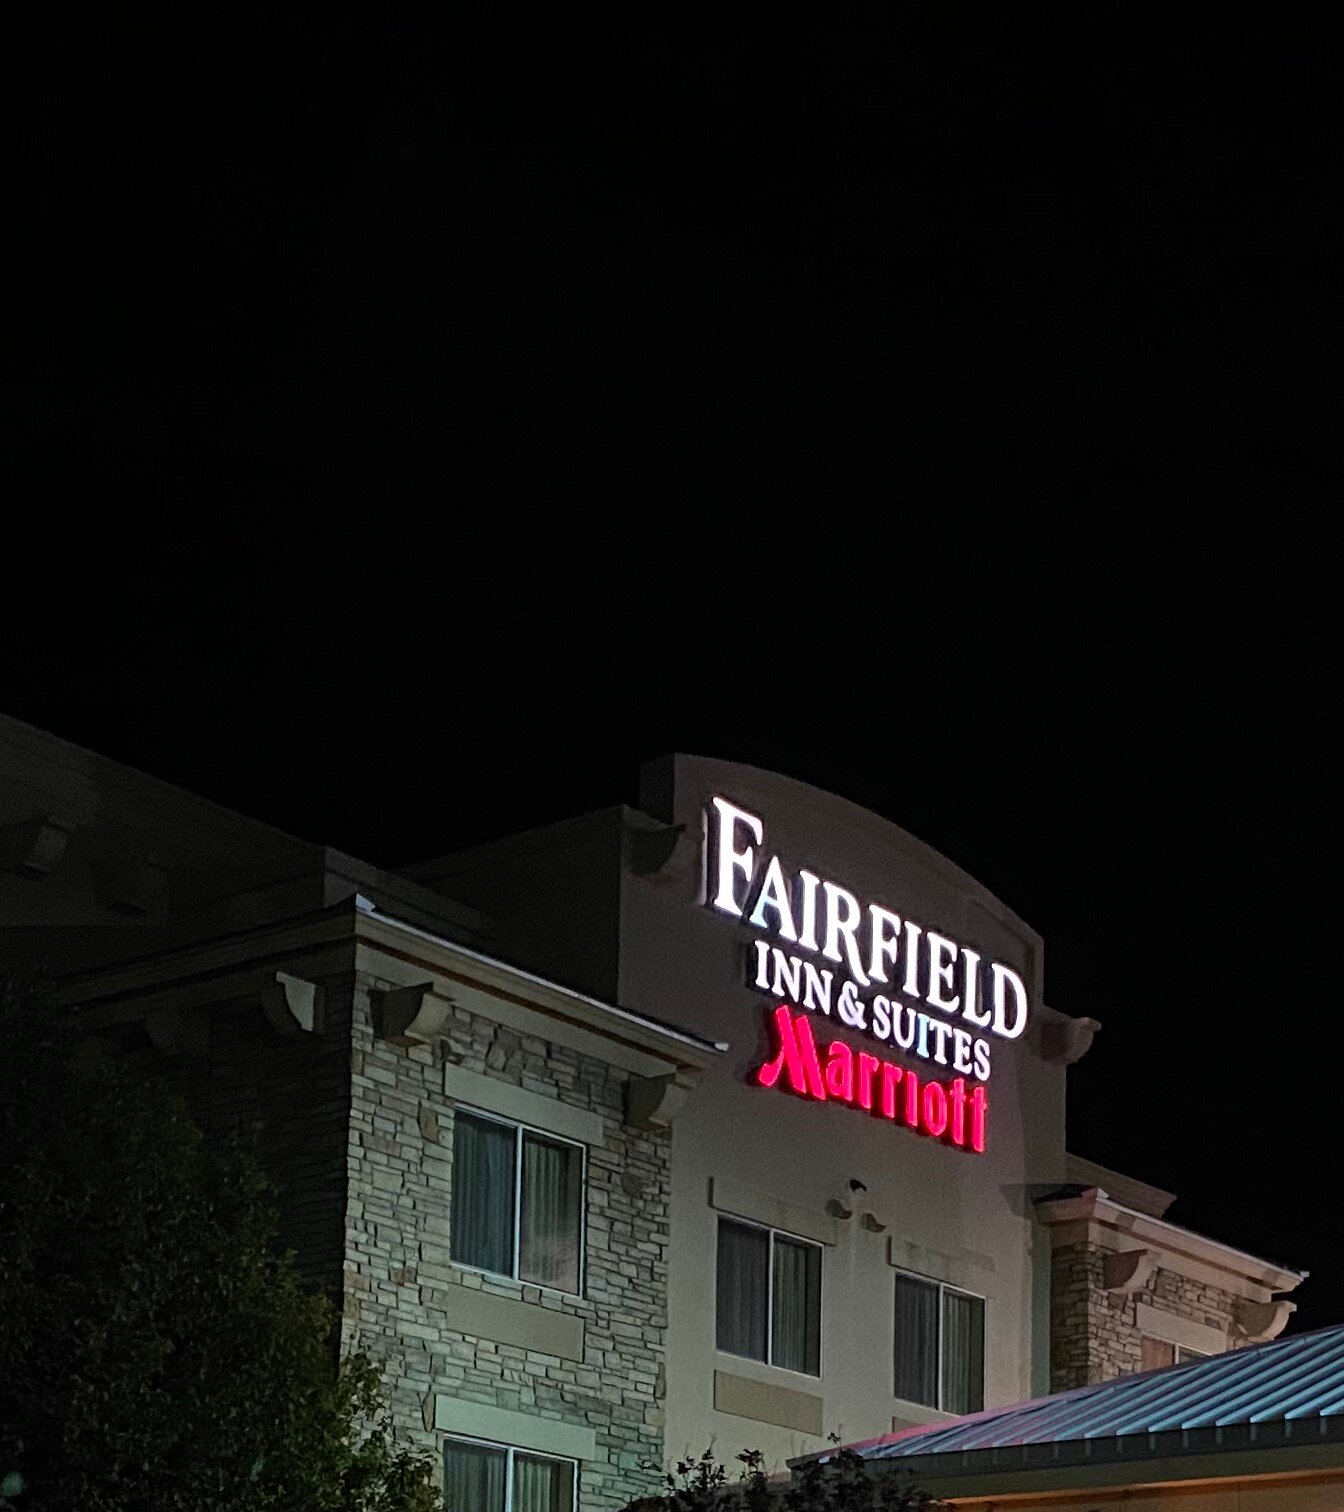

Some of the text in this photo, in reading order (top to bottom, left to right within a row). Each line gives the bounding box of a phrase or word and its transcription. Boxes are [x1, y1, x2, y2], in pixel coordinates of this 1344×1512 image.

[711, 796, 1029, 1040] FAIRFIELD
[754, 940, 992, 1082] INN & SUITES
[757, 1003, 988, 1153] Marriott
